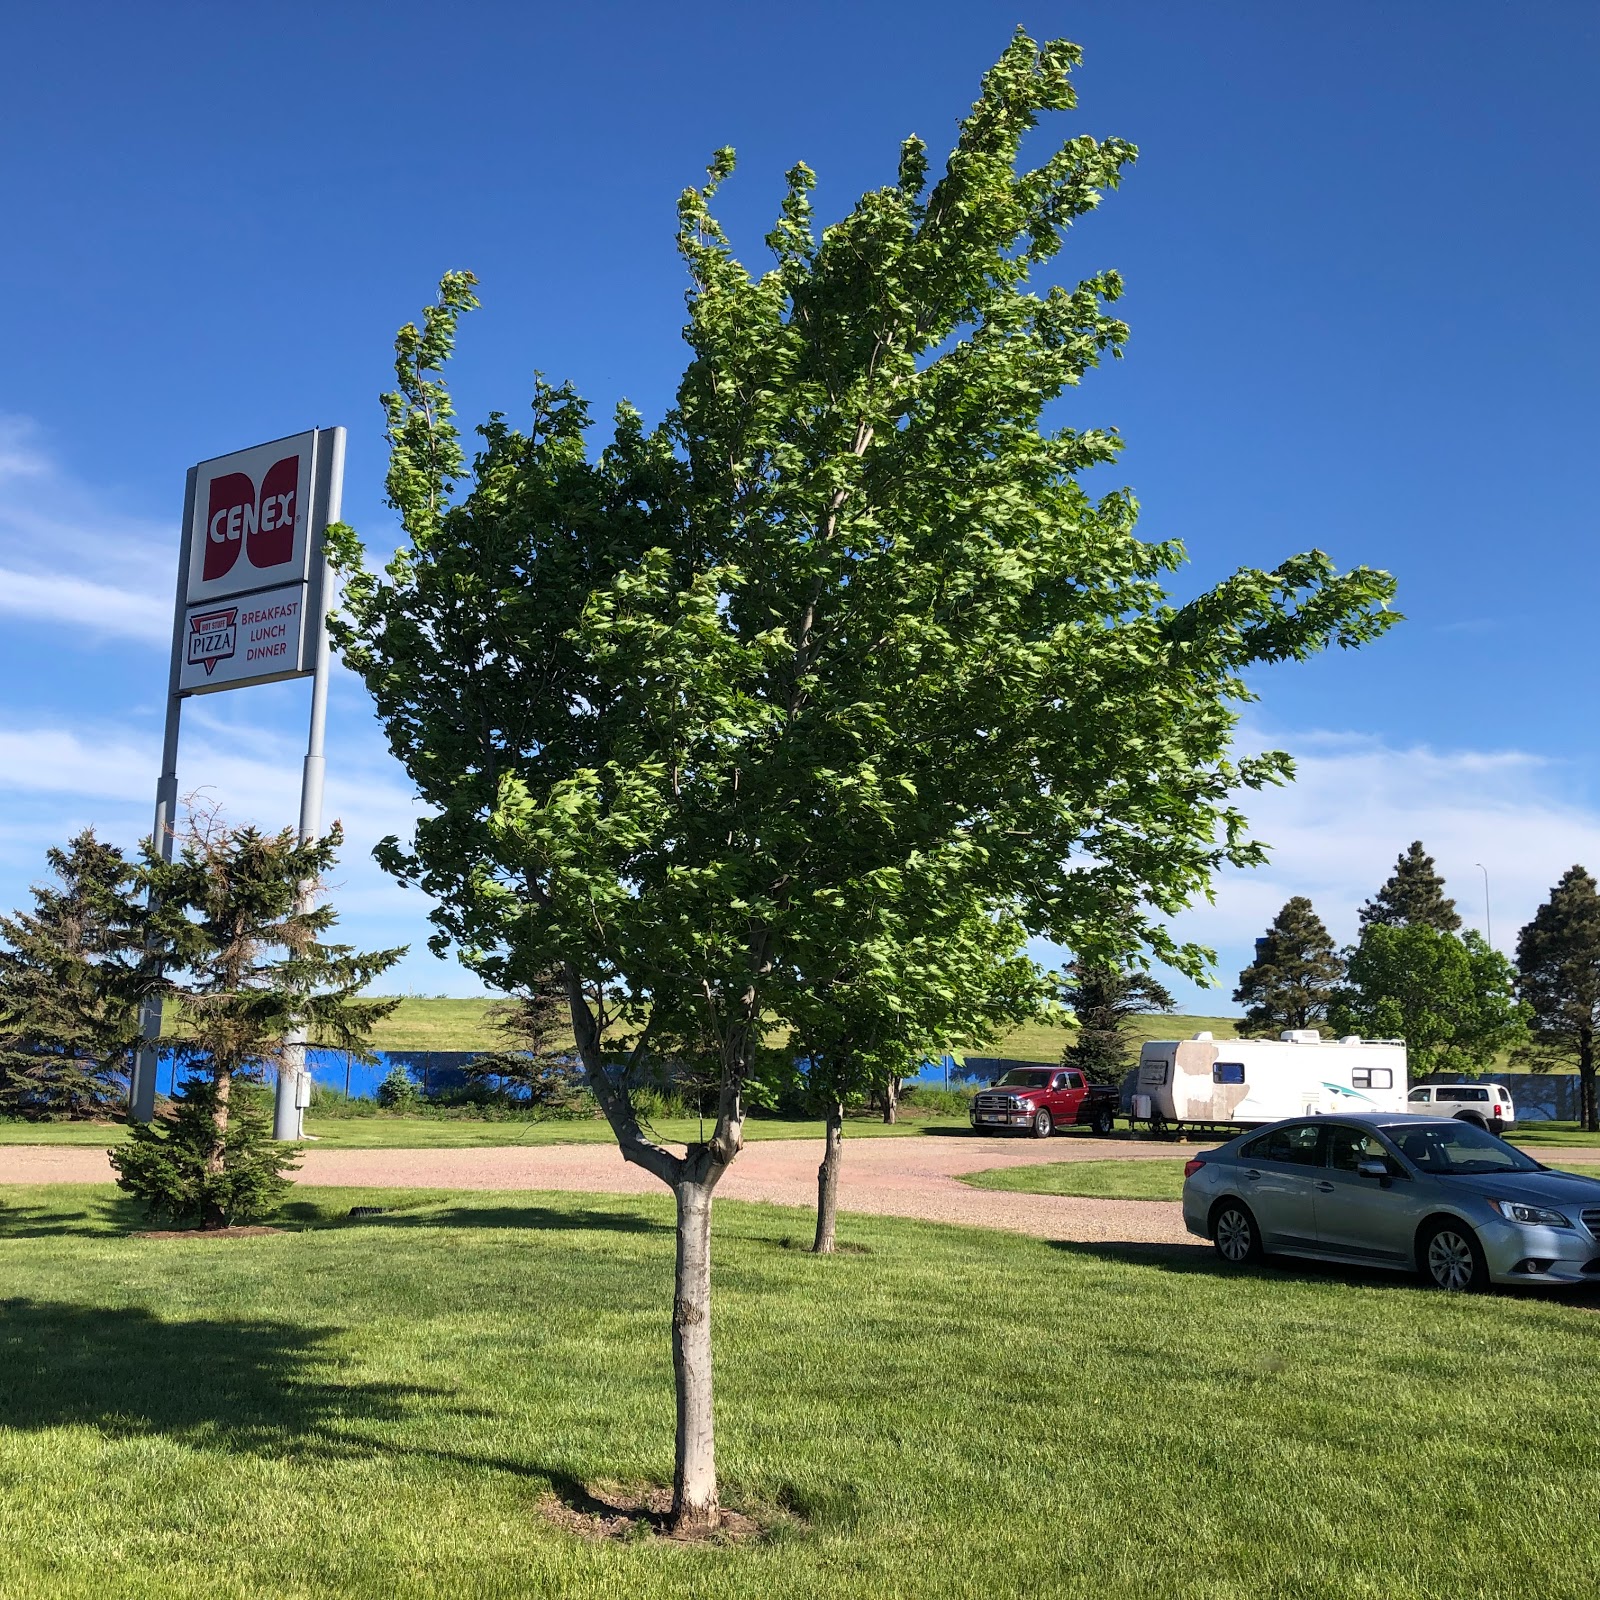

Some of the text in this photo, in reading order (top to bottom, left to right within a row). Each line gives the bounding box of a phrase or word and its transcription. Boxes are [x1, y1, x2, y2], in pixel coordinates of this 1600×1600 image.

[210, 491, 294, 543] CENEX
[241, 603, 298, 625] BREAKFAST
[251, 624, 286, 641] LUNCH
[194, 633, 231, 654] PIZZA
[247, 643, 287, 660] DINNER
